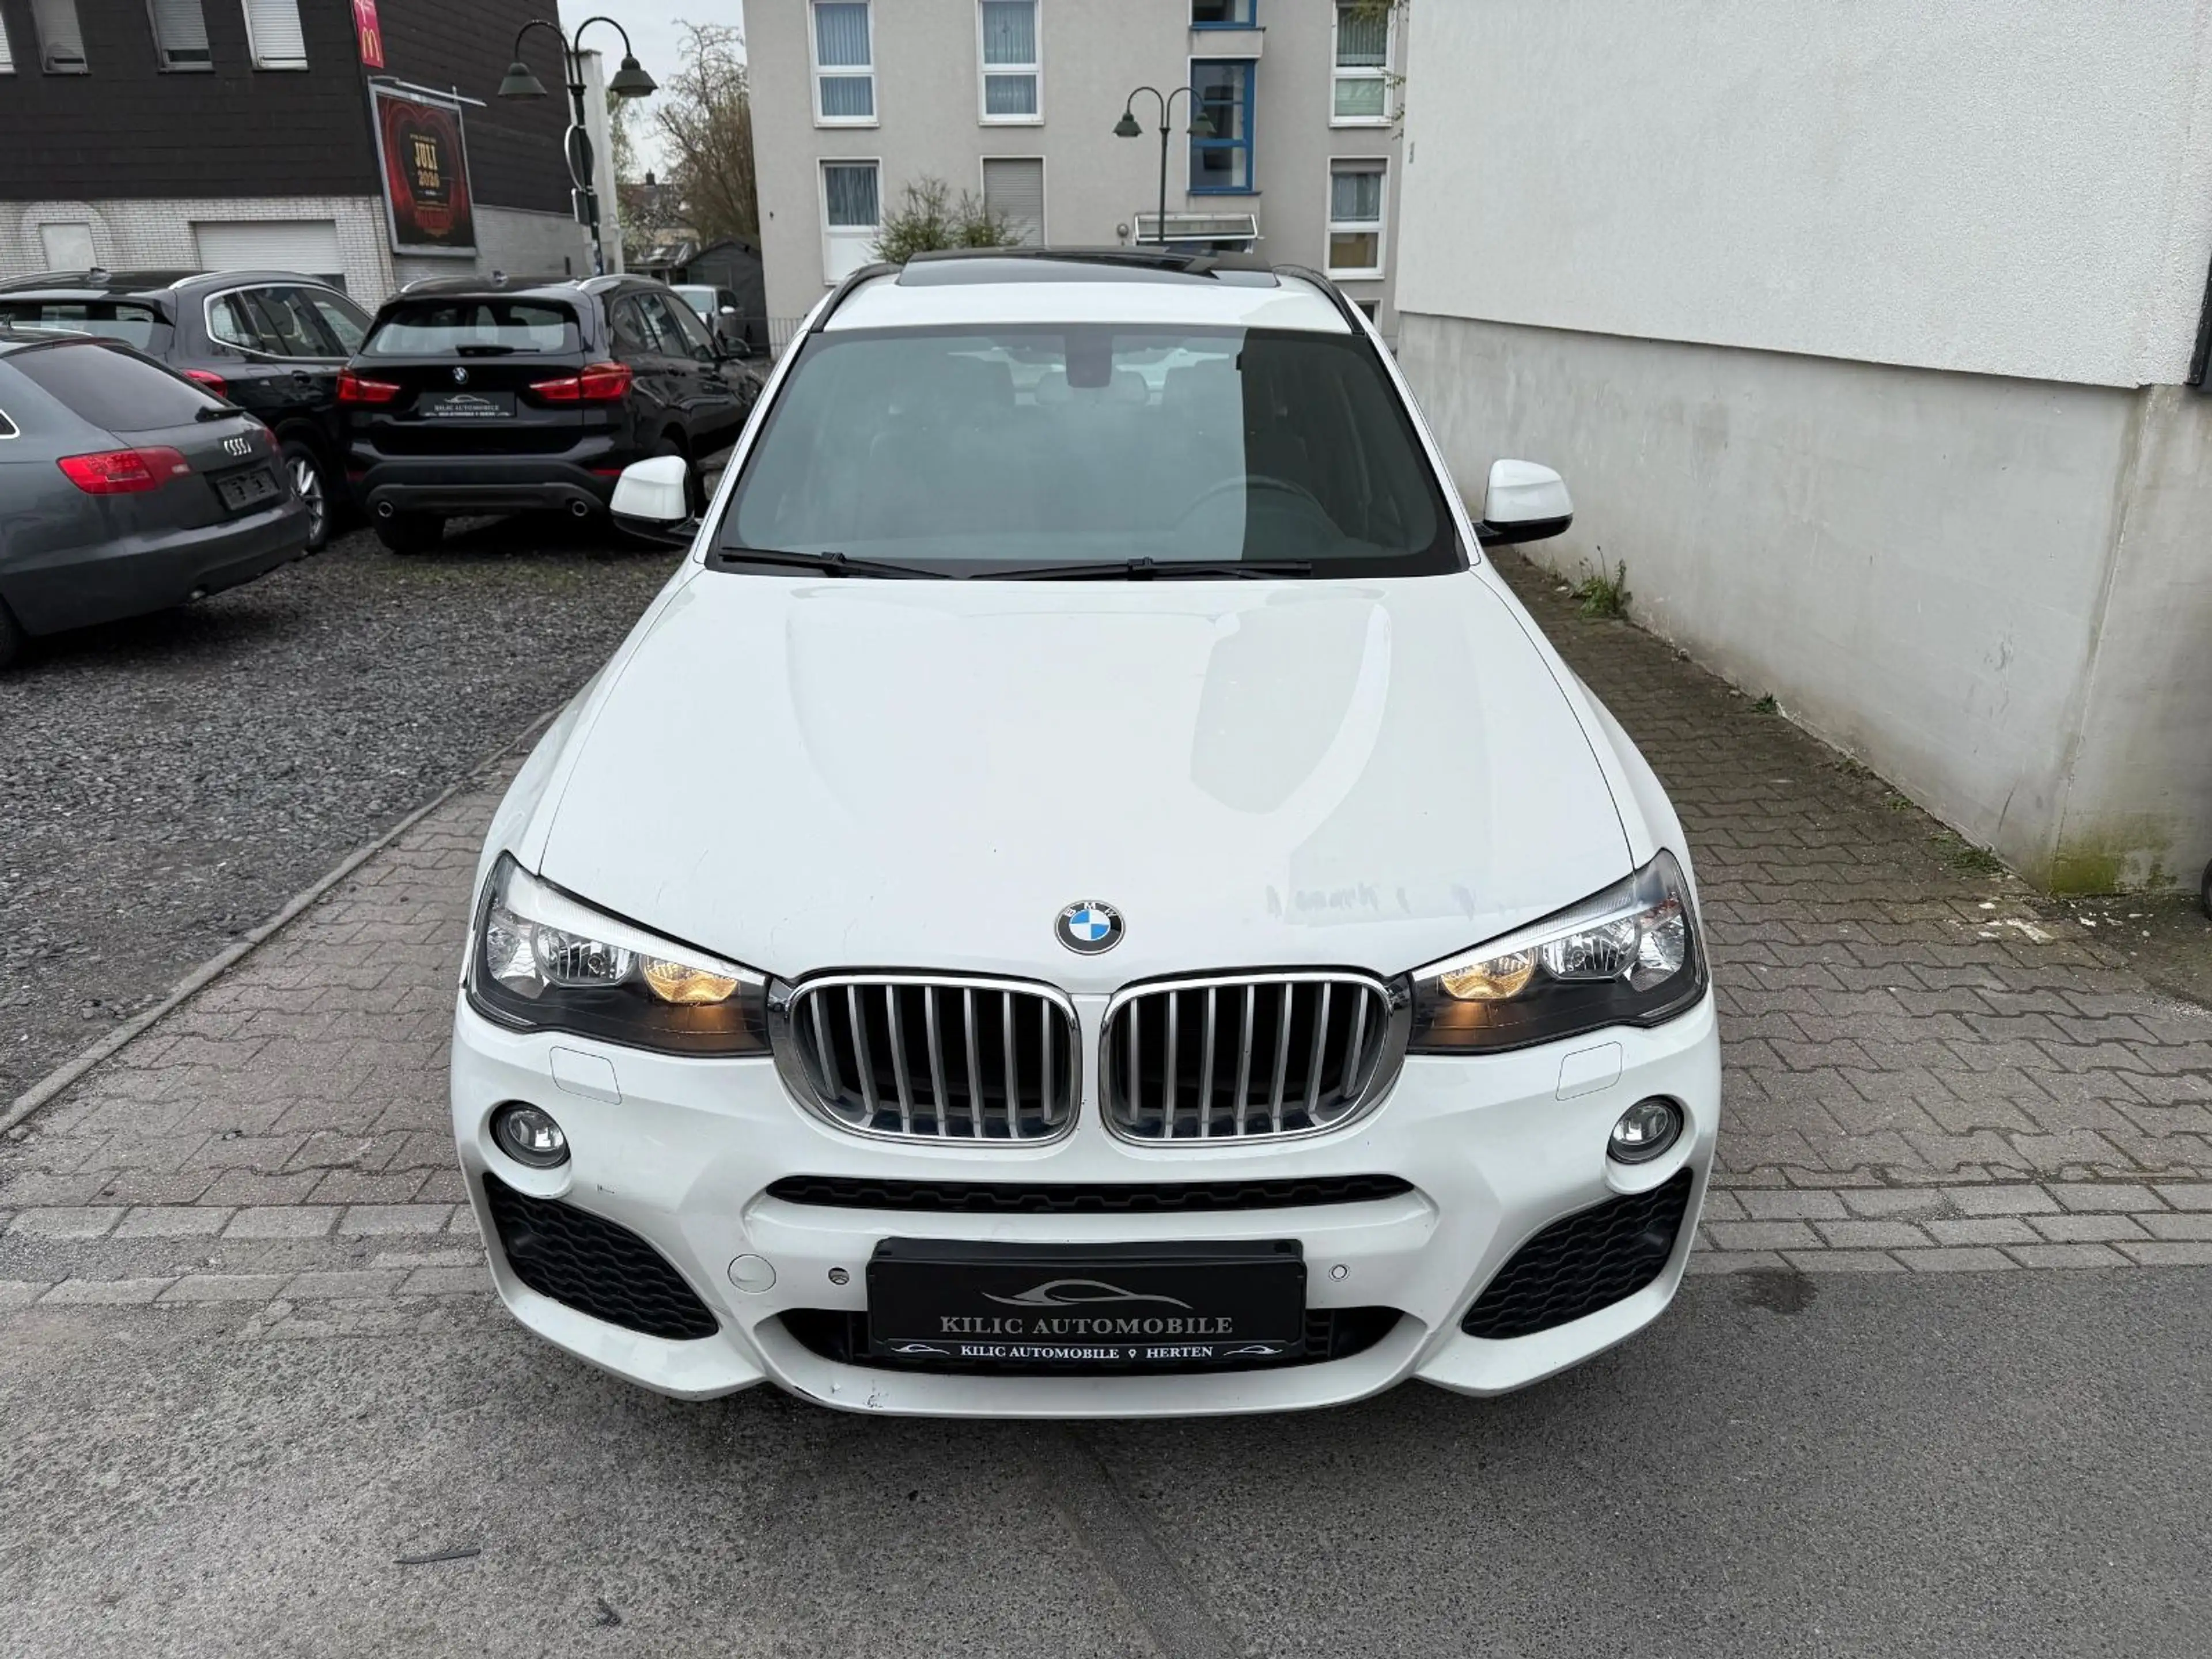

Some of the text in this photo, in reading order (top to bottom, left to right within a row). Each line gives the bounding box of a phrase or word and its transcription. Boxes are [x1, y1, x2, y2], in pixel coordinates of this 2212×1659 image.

[940, 1316, 1233, 1334] KILIC AUTOMOBILE
[960, 1345, 1214, 1359] KILIC AUTOMOBILE HERTEN
